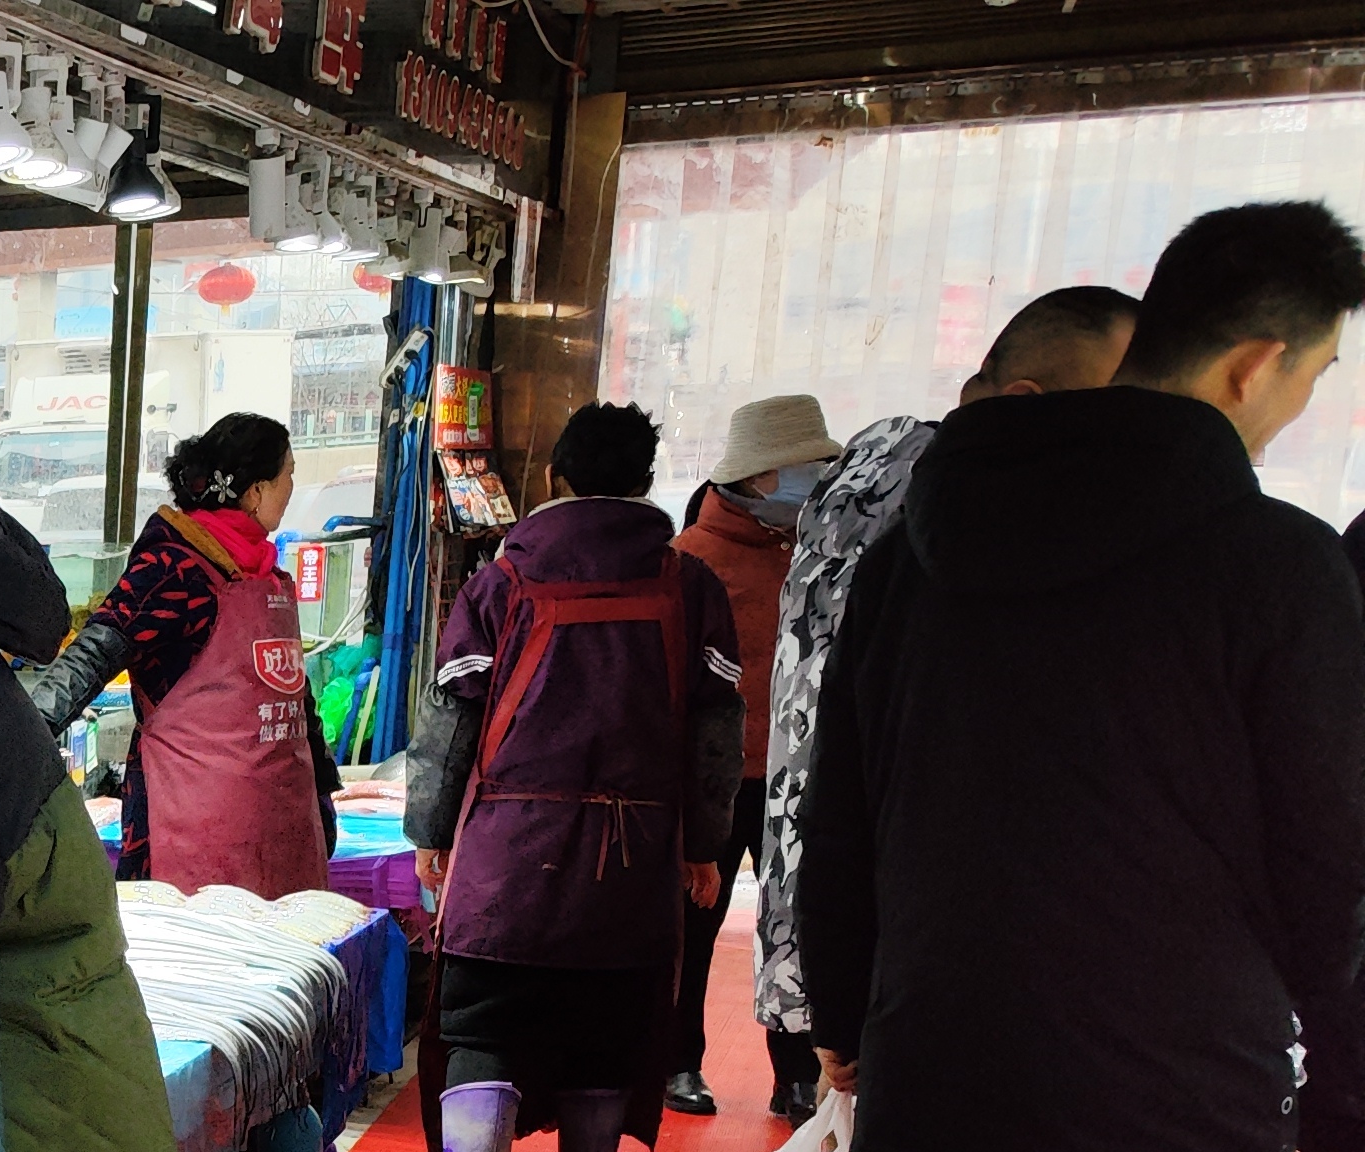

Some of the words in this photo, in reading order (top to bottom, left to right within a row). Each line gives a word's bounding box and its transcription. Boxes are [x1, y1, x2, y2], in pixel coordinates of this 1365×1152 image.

[36, 395, 108, 411] JAC
[301, 549, 318, 599] 帝王蟹
